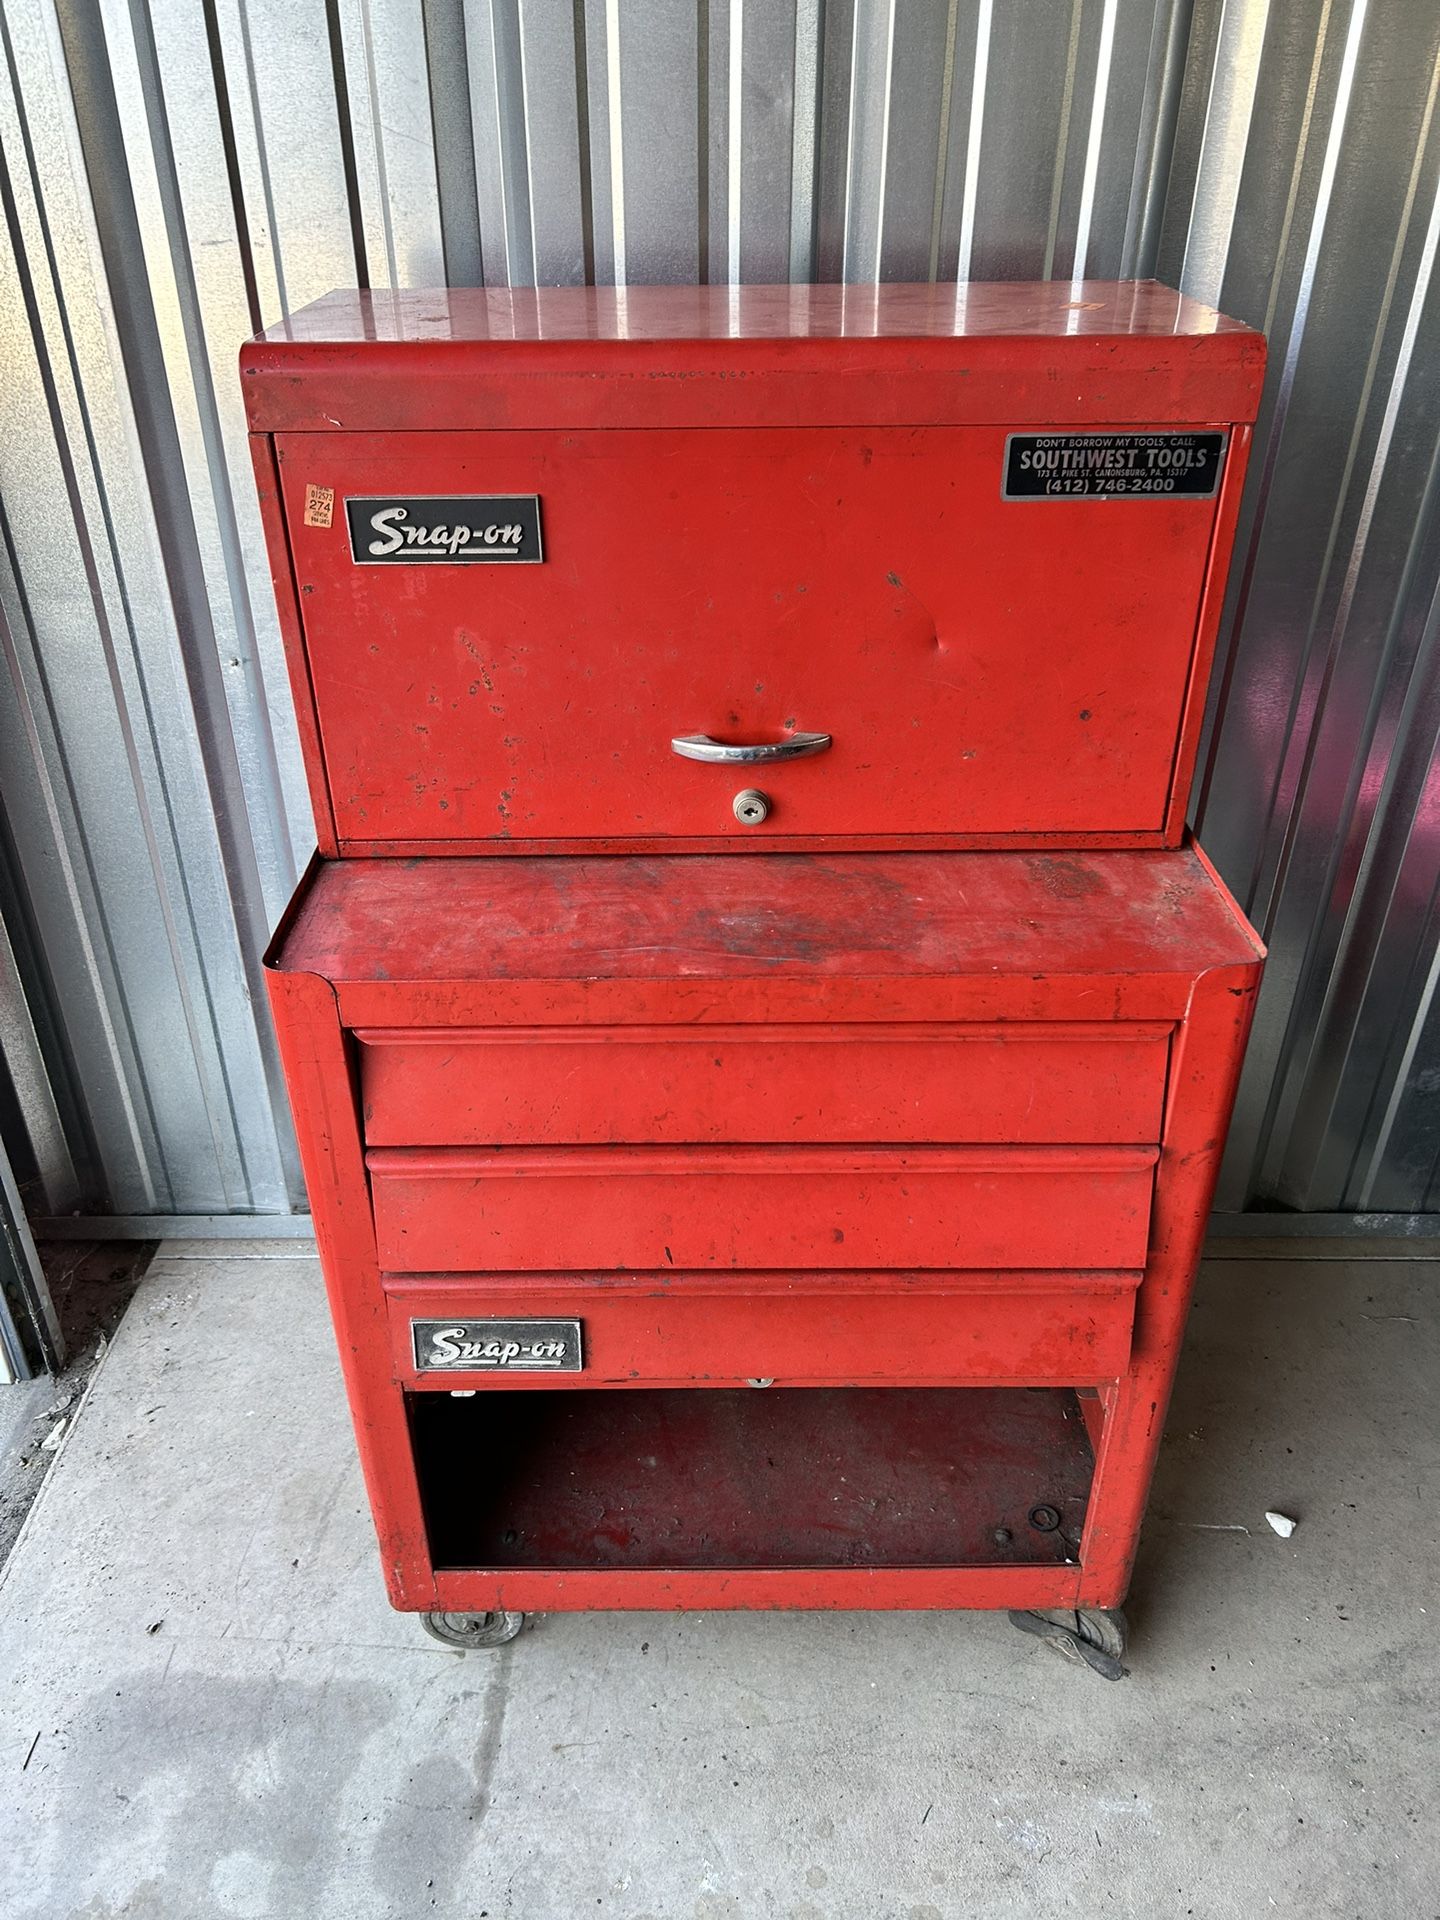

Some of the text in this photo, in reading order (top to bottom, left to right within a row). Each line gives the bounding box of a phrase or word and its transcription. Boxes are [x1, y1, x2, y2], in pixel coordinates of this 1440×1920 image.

[1036, 437, 1196, 448] DON'T BORROW MY TOOLS, CALL:
[1020, 448, 1208, 470] SOUTHWEST TOOLS
[1037, 469, 1051, 478] 173
[1052, 469, 1060, 477] E.
[1061, 469, 1079, 477] PIKE
[1081, 469, 1092, 477] ST.
[1150, 468, 1163, 476] PA.
[1166, 468, 1189, 476] 15317
[1046, 478, 1175, 494] (412) 746-2400
[309, 499, 331, 513] 274
[368, 507, 523, 556] Snap-on
[429, 1328, 566, 1365] Snap-on
